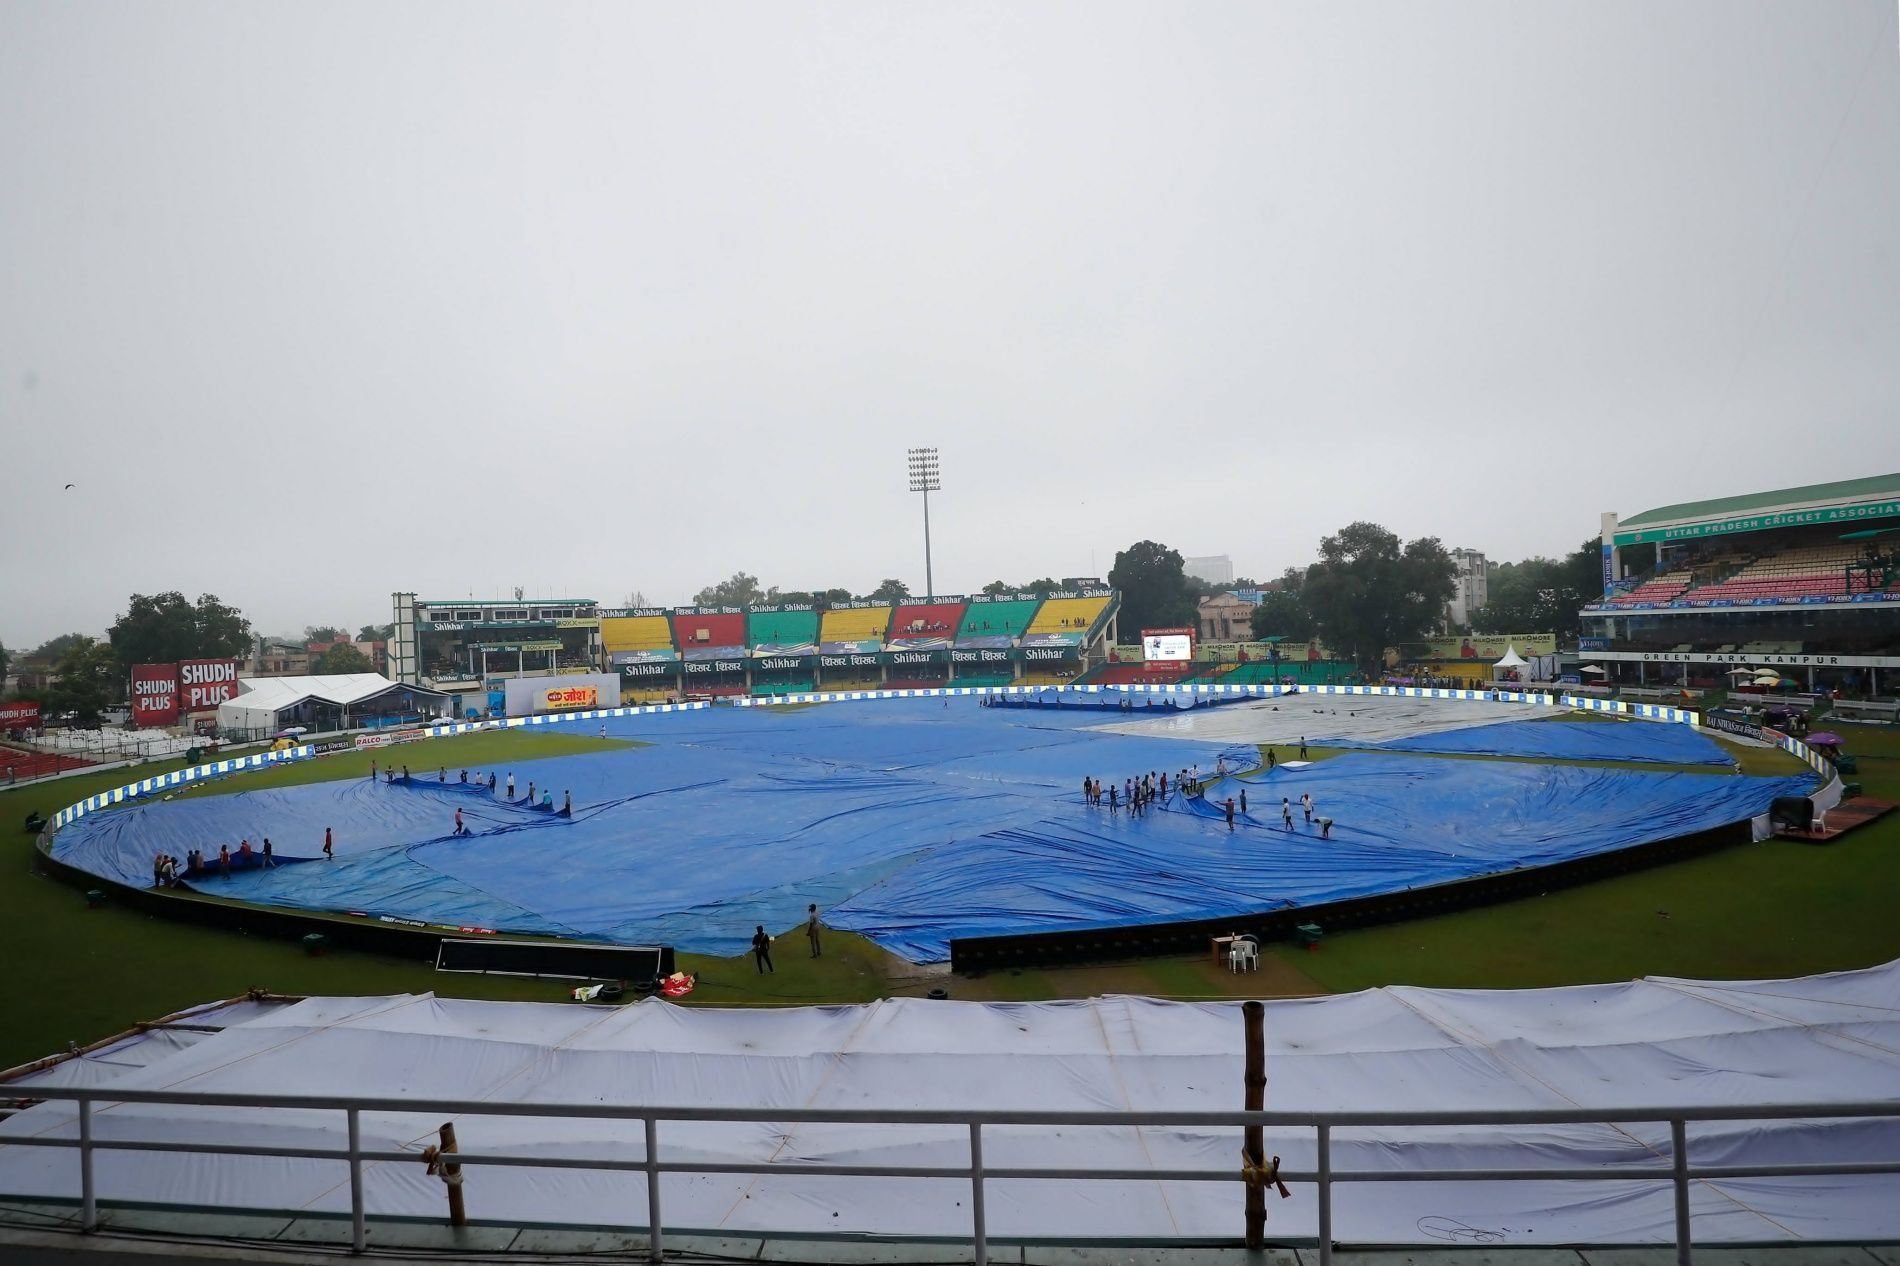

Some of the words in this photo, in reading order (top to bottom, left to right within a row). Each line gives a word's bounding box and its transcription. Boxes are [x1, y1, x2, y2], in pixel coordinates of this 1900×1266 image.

[1666, 527, 1699, 538] UTTAR
[1705, 520, 1758, 534] PRADESH
[1764, 512, 1821, 526] CRICKET
[1048, 590, 1078, 599] Shikhar
[1083, 588, 1113, 598] Shikhar
[900, 598, 928, 606] Shikhar
[933, 596, 962, 605] Shikhar
[597, 609, 628, 619] Shikhar
[633, 608, 664, 617] Shikhar
[750, 604, 779, 613] Shikhar
[784, 603, 813, 611] Shikhar
[434, 622, 465, 631] Shikhar
[893, 652, 932, 664] Shikhar
[1025, 649, 1065, 660] Shikhar
[1644, 653, 1691, 661] GREEN
[1764, 655, 1838, 664] KANPUR
[761, 658, 800, 669] Shikhar
[181, 663, 235, 685] SHUDH
[625, 664, 667, 676] Shikhar
[135, 680, 175, 695] SHUDH
[191, 686, 230, 707] PLUS
[563, 688, 586, 701] जोश
[141, 697, 171, 711] PLUS
[20, 708, 38, 717] PLUS
[1706, 715, 1717, 727] RAJ
[1717, 719, 1735, 730] NIWAS
[356, 737, 381, 746] RALCO
